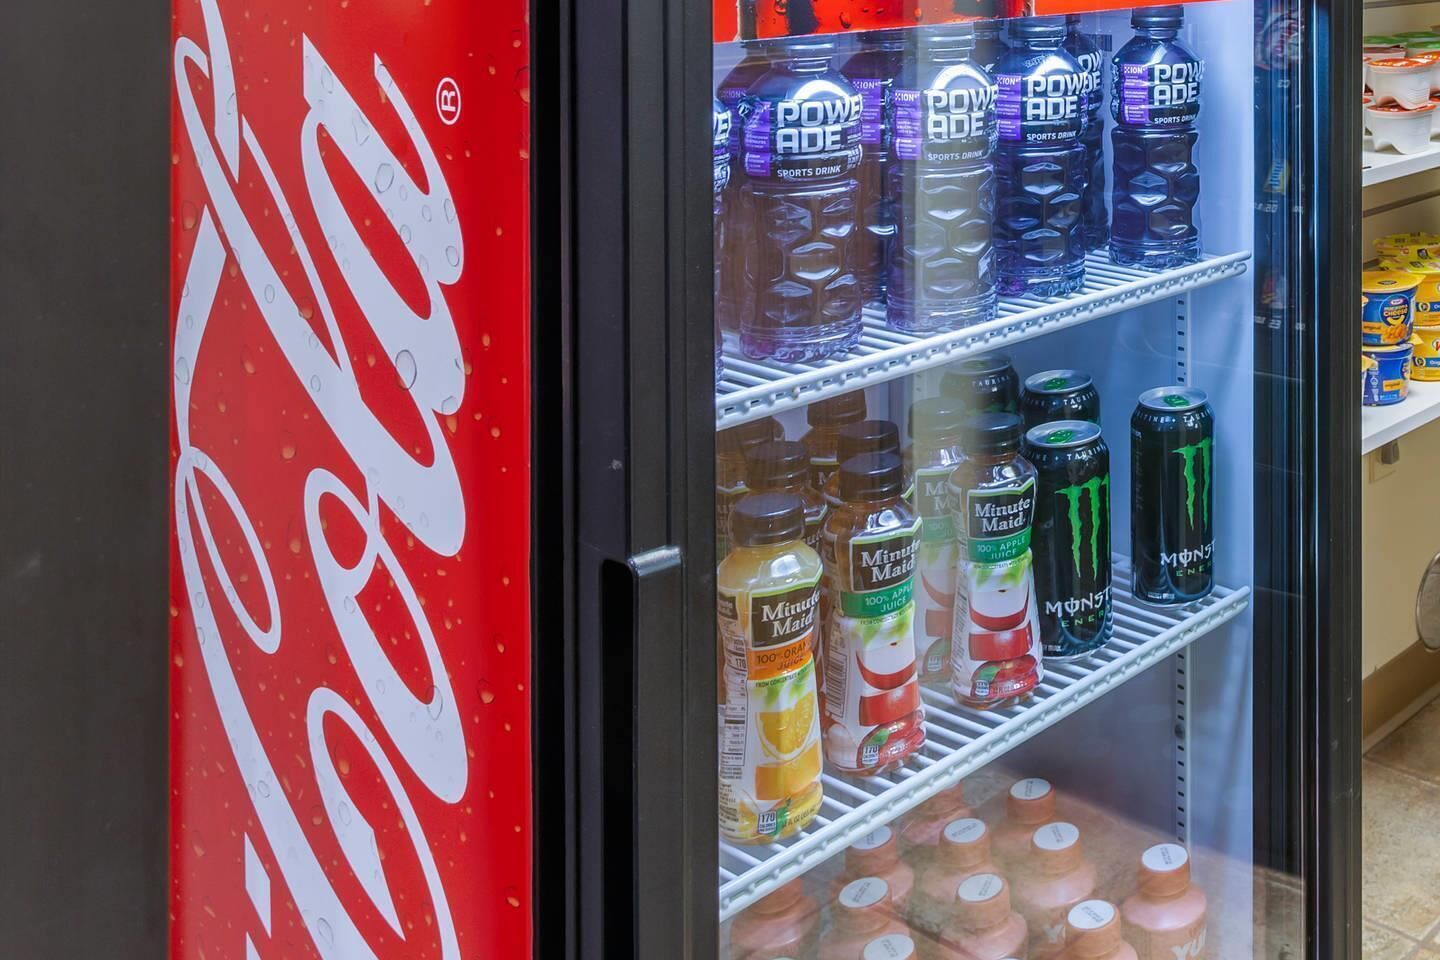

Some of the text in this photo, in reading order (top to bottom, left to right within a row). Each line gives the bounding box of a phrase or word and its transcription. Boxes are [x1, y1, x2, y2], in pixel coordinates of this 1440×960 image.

[1153, 83, 1198, 106] ADE
[1026, 97, 1079, 121] ADE
[927, 112, 985, 140] ADE
[1154, 116, 1181, 124] SPORTS
[776, 124, 844, 154] ADE
[1026, 131, 1077, 141] SPORTS DRINK
[928, 150, 984, 161] SPORTS DRINK
[777, 164, 842, 178] SPORTS DRINK
[974, 498, 1031, 518] Minute
[981, 511, 1026, 533] Maid
[861, 539, 921, 568] Minute
[999, 535, 1026, 551] APPLE
[991, 548, 1017, 560] JUICE
[871, 553, 915, 583] Maid
[761, 589, 820, 623] Minute
[880, 595, 907, 613] JUICE
[771, 606, 815, 638] Maid
[760, 812, 776, 824] 170
